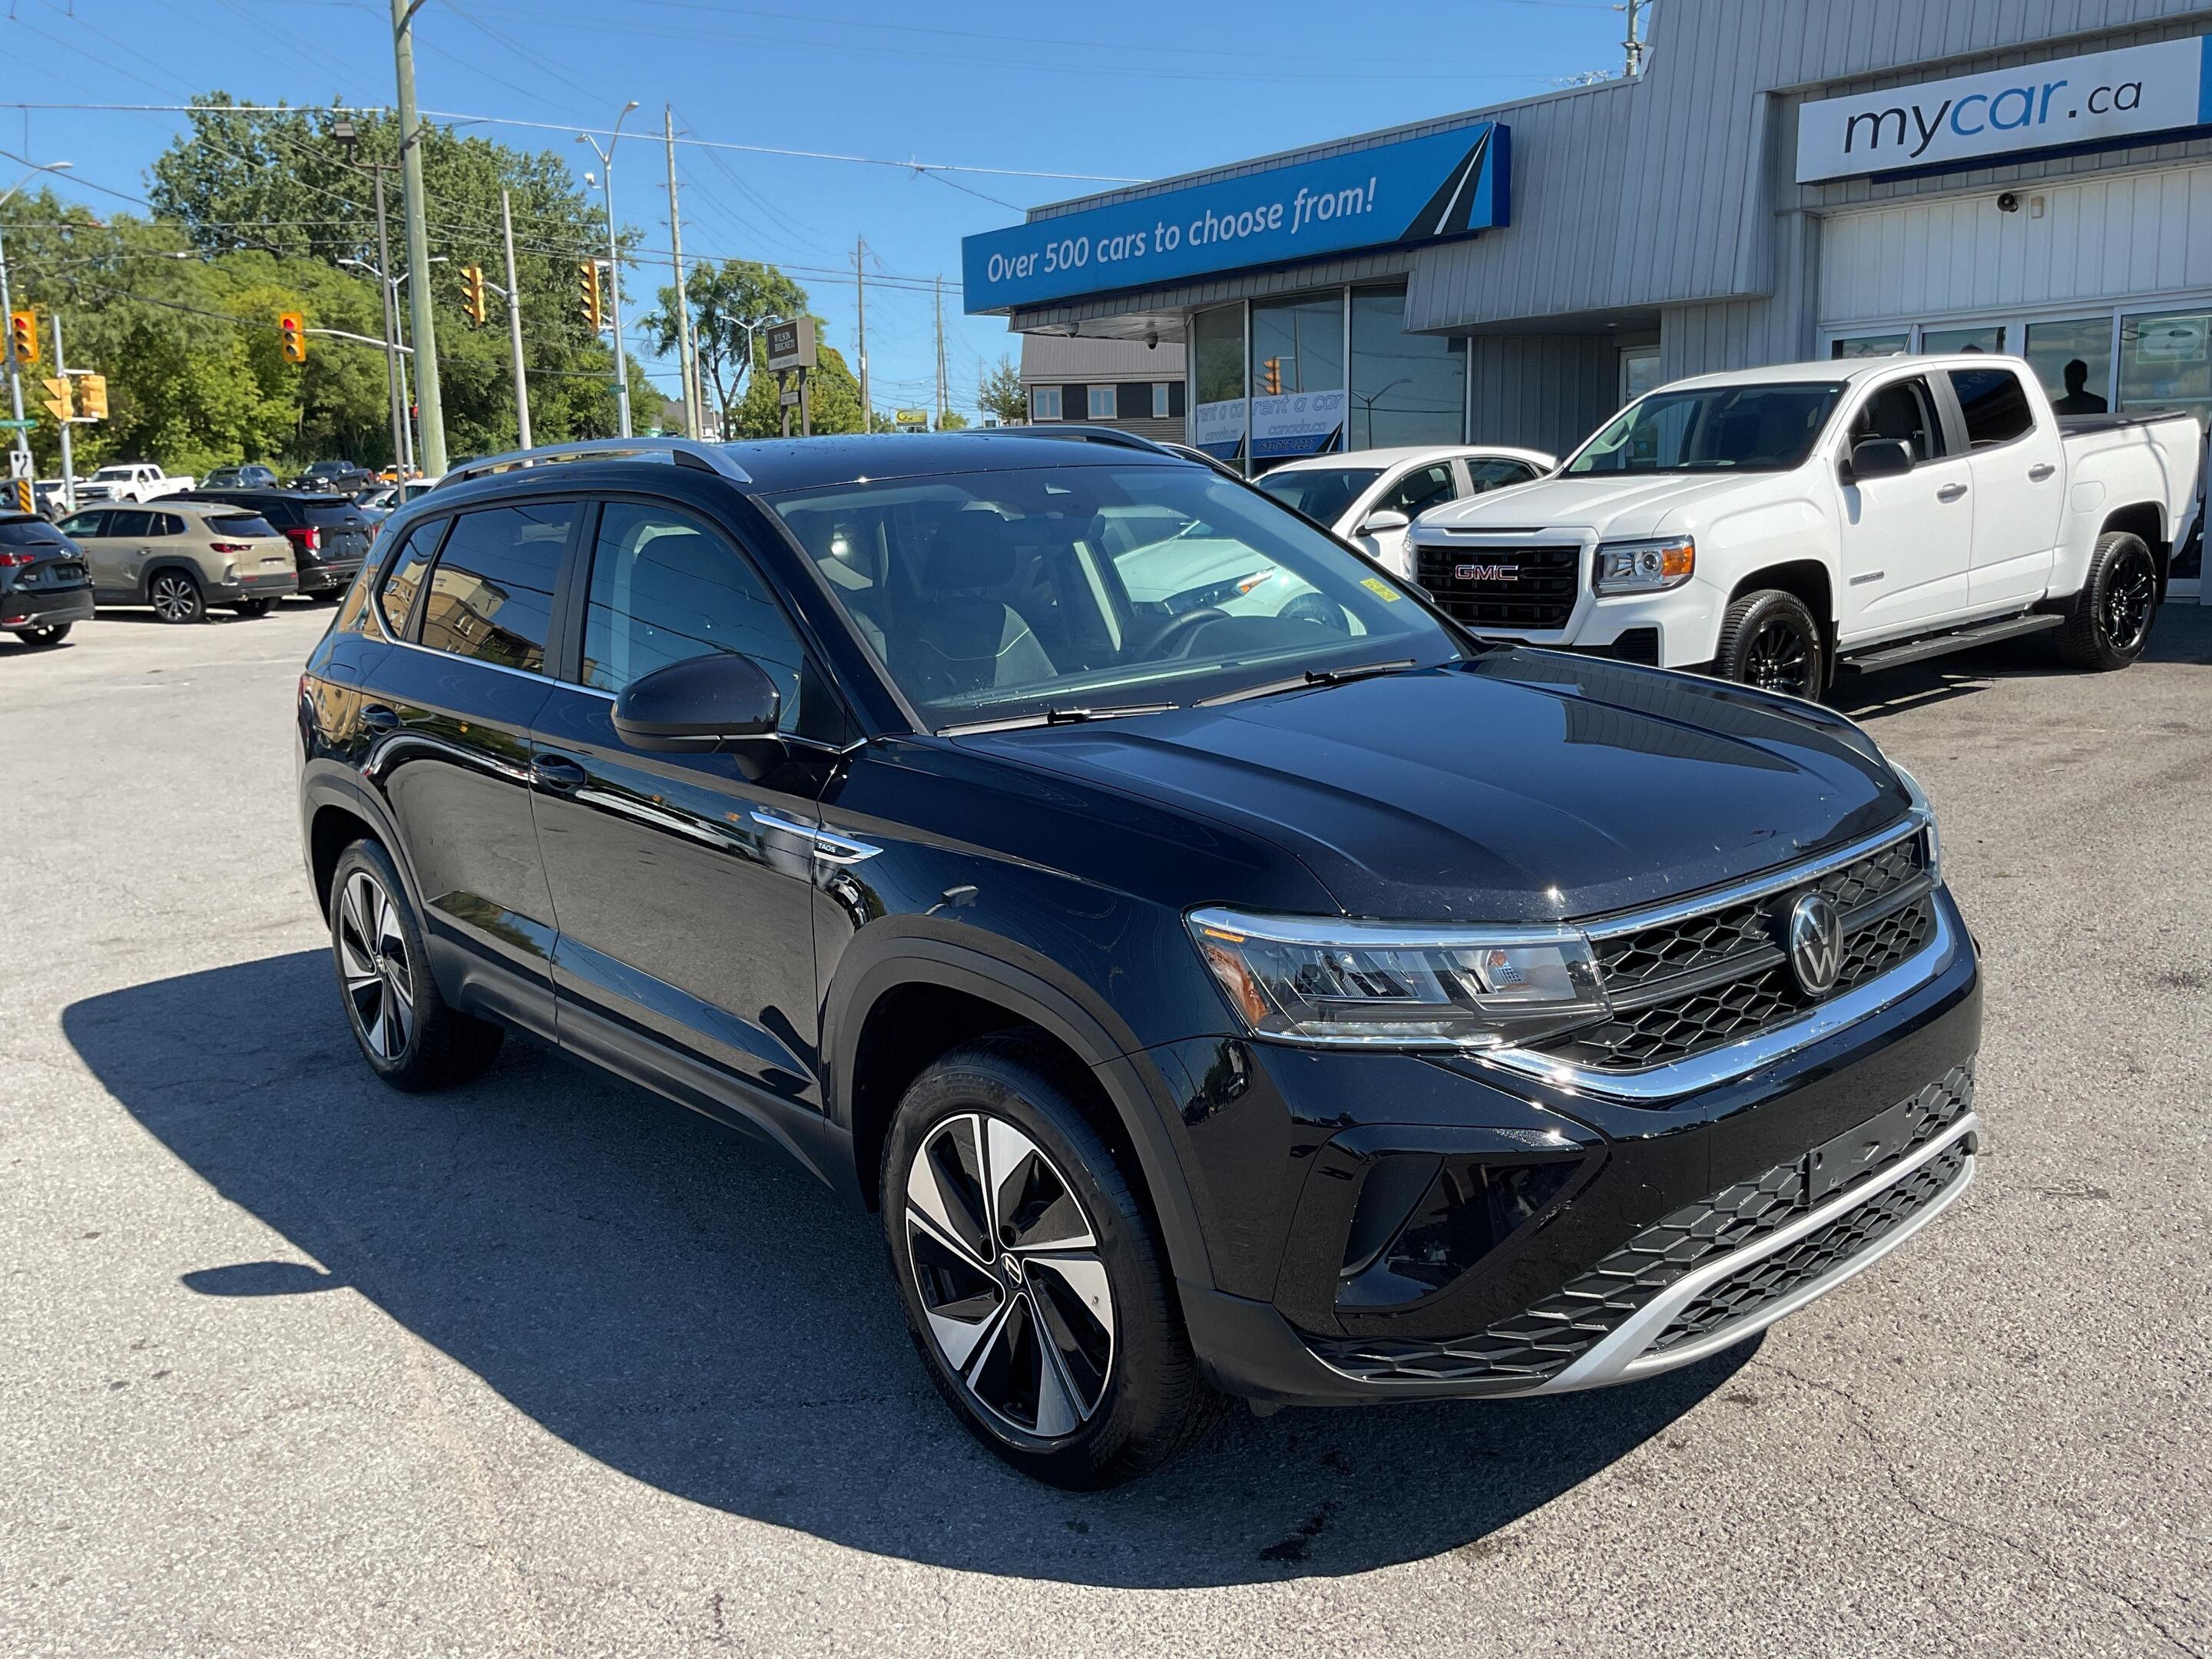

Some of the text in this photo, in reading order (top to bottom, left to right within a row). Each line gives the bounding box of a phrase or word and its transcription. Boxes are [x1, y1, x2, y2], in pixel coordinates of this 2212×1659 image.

[988, 177, 1377, 283] Over 500 cars to choose from!
[1252, 393, 1343, 416] rent a car
[1455, 565, 1518, 581] GMC
[817, 842, 836, 853] TAOS
